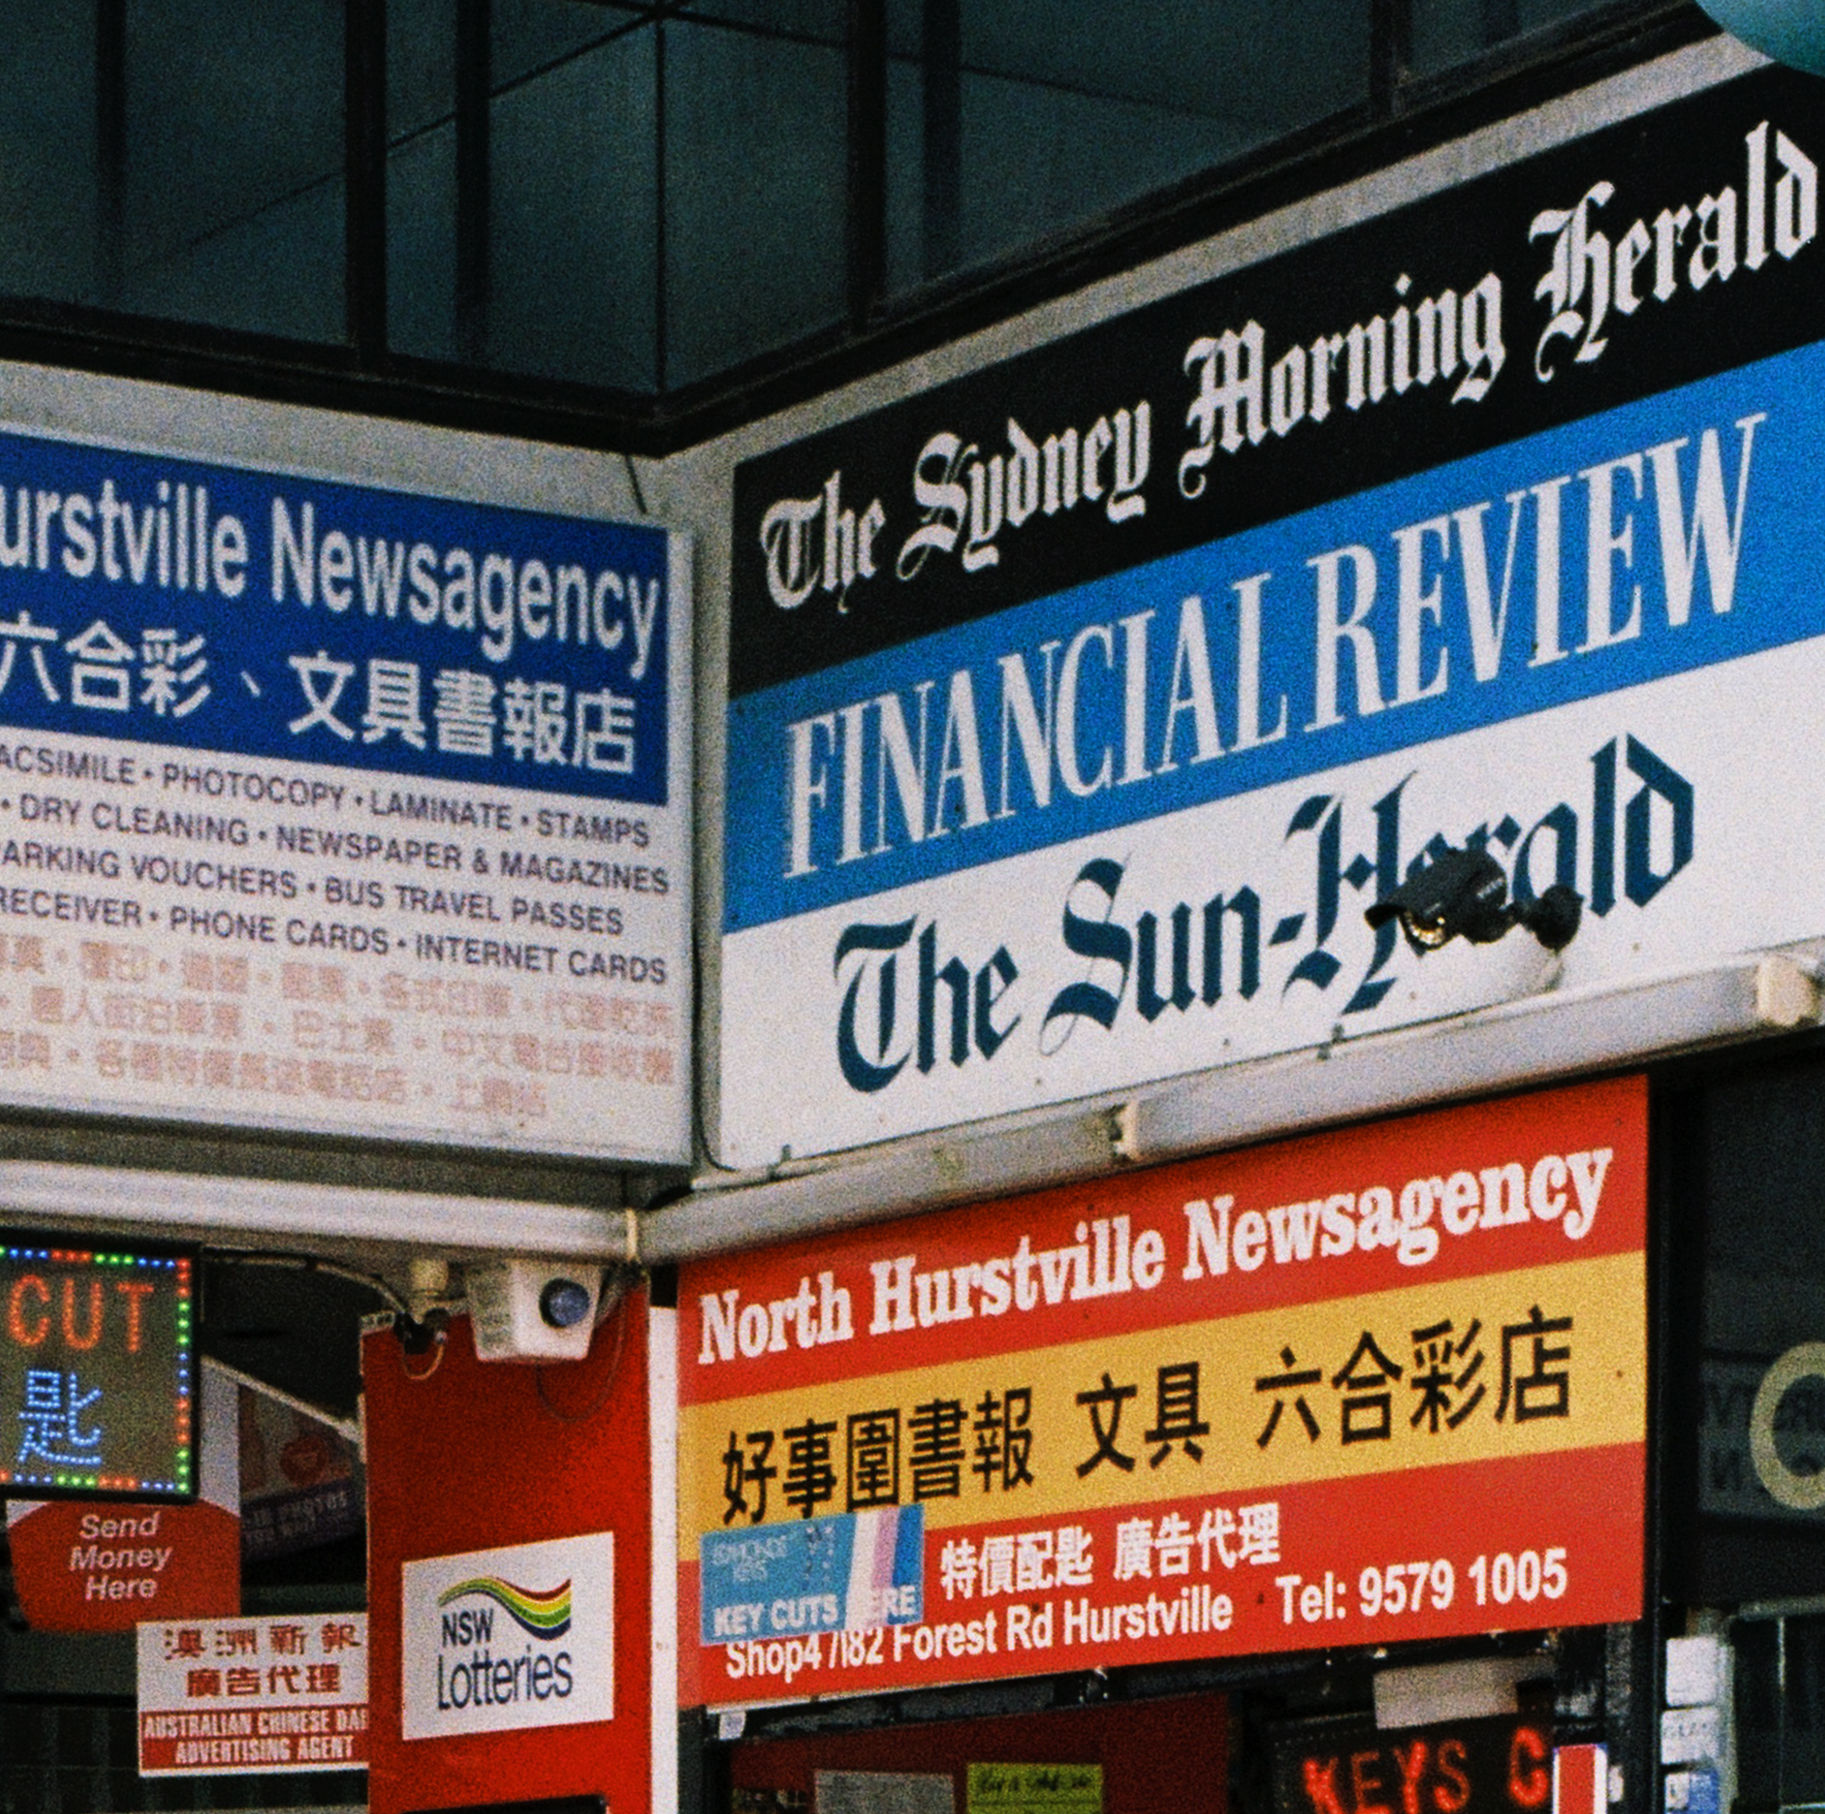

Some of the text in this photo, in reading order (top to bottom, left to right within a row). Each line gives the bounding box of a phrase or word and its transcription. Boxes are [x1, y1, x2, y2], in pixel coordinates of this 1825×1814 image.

[759, 120, 1820, 612] The Sydney Morning Herald
[269, 494, 660, 677] Newsagency
[784, 411, 1767, 880] FINANCIAL REVIEW
[18, 790, 84, 828] DRY
[90, 799, 250, 850] CLEANING
[276, 822, 466, 873] NEWSPAPER
[470, 843, 494, 876] &
[499, 848, 670, 897] MAGAZINES
[161, 761, 347, 815] PHOTOCOPY
[371, 789, 514, 835] LAMINATE
[535, 808, 651, 849] STAMPS
[131, 850, 299, 902] VOUCHERS
[324, 874, 387, 910] BUS
[393, 882, 504, 925] TRAVEL
[510, 895, 625, 937] PASSES
[169, 905, 280, 948] PHONE
[285, 916, 390, 960] CARDS
[414, 933, 562, 978] INTERNET
[568, 948, 668, 988] CARDS
[833, 912, 1022, 1094] The
[696, 1147, 1614, 1368] North Hurstville Newsagency
[7, 1271, 155, 1355] CUT
[722, 1302, 1576, 1528] 好事圍書報 文具 六合彩店
[69, 1542, 174, 1576] Money
[78, 1511, 161, 1541] Send
[939, 1500, 1282, 1604] 特價配匙 廣告代理
[84, 1573, 159, 1602] Here
[441, 1608, 495, 1648] NSW
[713, 1602, 764, 1637] KEY
[769, 1593, 839, 1630] CUTS
[892, 1606, 996, 1665] Forest
[1005, 1602, 1054, 1650] Rd
[1063, 1584, 1234, 1647] Hurstville
[1275, 1573, 1349, 1626] Tel:
[1359, 1559, 1453, 1619] 9579
[1468, 1546, 1570, 1606] 1005
[187, 1663, 341, 1698] 廣告代理
[437, 1643, 574, 1712] Lotteries
[144, 1711, 253, 1738] AUSTRALIAN
[257, 1708, 331, 1735] CHINESE
[176, 1734, 355, 1765] ADVERTISING AGENT
